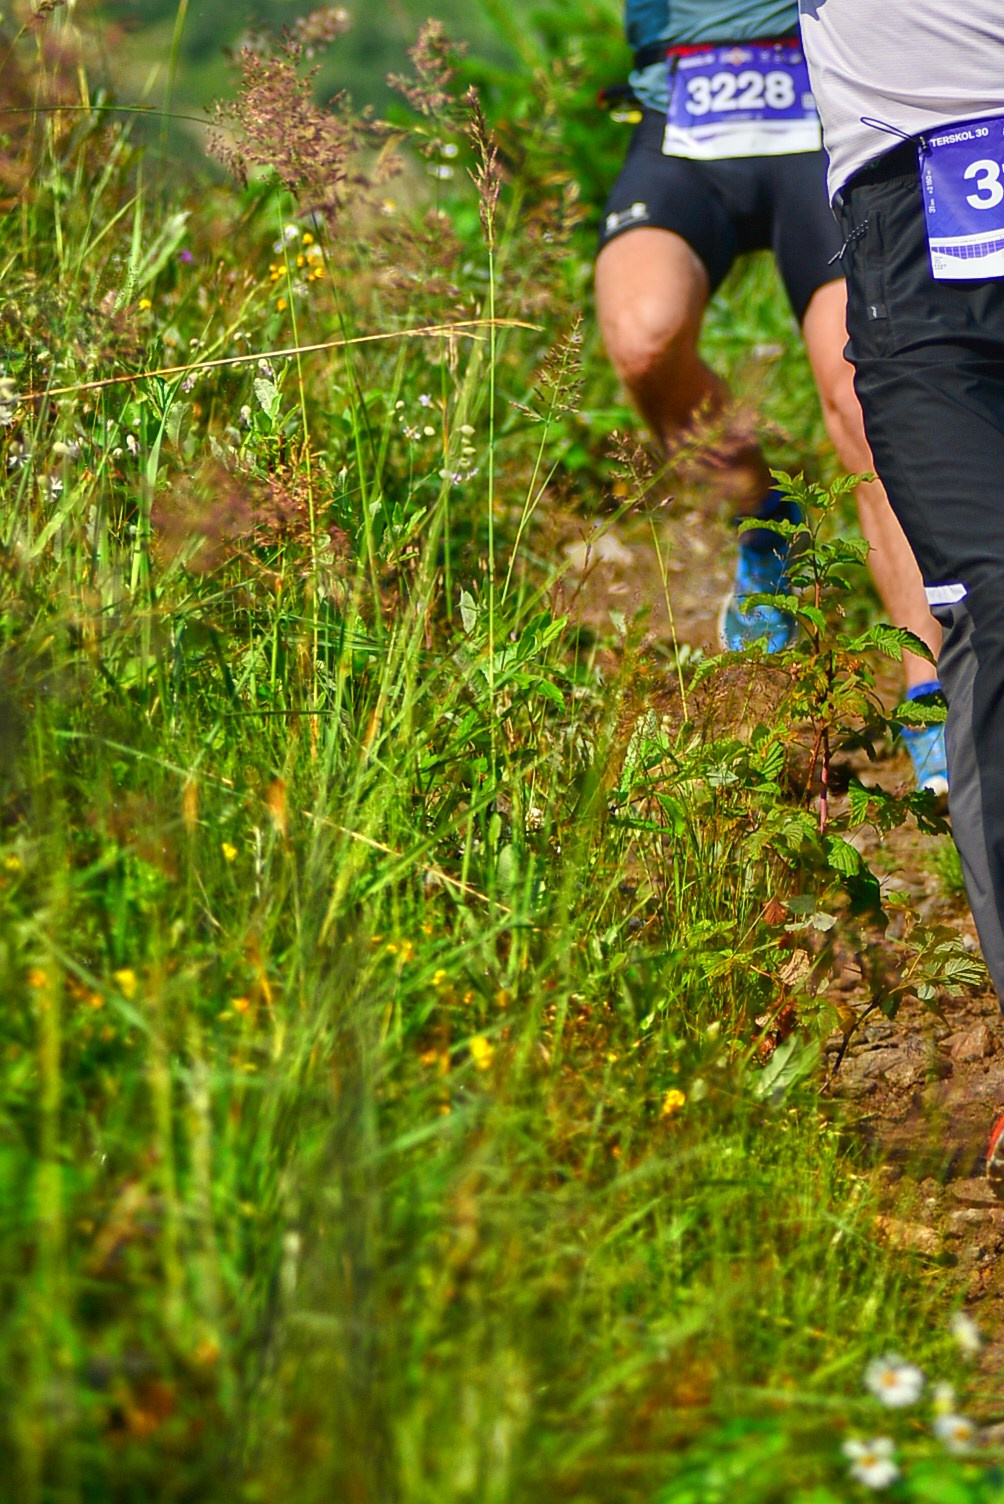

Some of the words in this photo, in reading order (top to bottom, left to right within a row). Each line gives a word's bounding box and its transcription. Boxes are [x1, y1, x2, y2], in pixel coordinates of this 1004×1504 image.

[684, 70, 795, 116] 3228
[929, 130, 975, 147] TERSKOL
[975, 127, 989, 137] 30
